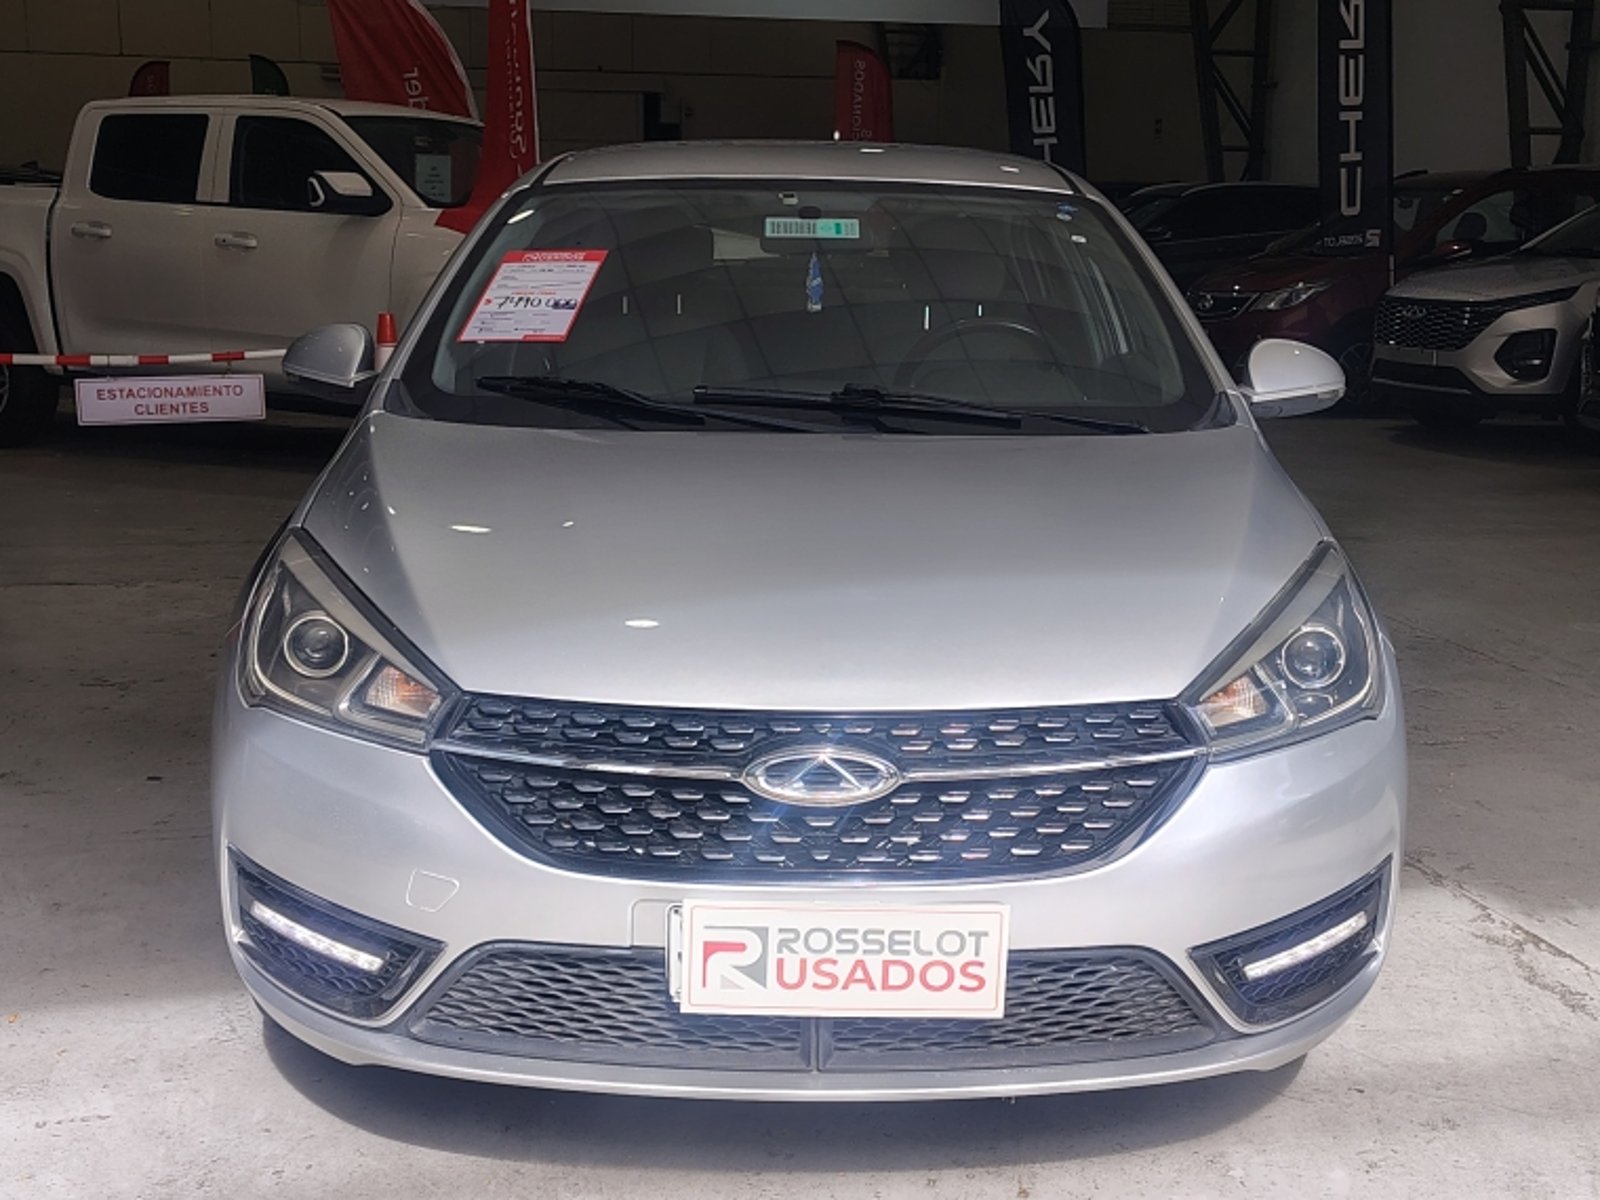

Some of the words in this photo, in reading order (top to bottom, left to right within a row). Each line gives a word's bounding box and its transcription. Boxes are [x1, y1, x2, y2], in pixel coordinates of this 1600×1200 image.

[96, 385, 243, 400] ESTACIONAMIENTO
[134, 402, 209, 415] CLIENTES
[776, 927, 989, 957] ROSSELOT
[776, 957, 986, 993] USADOS
